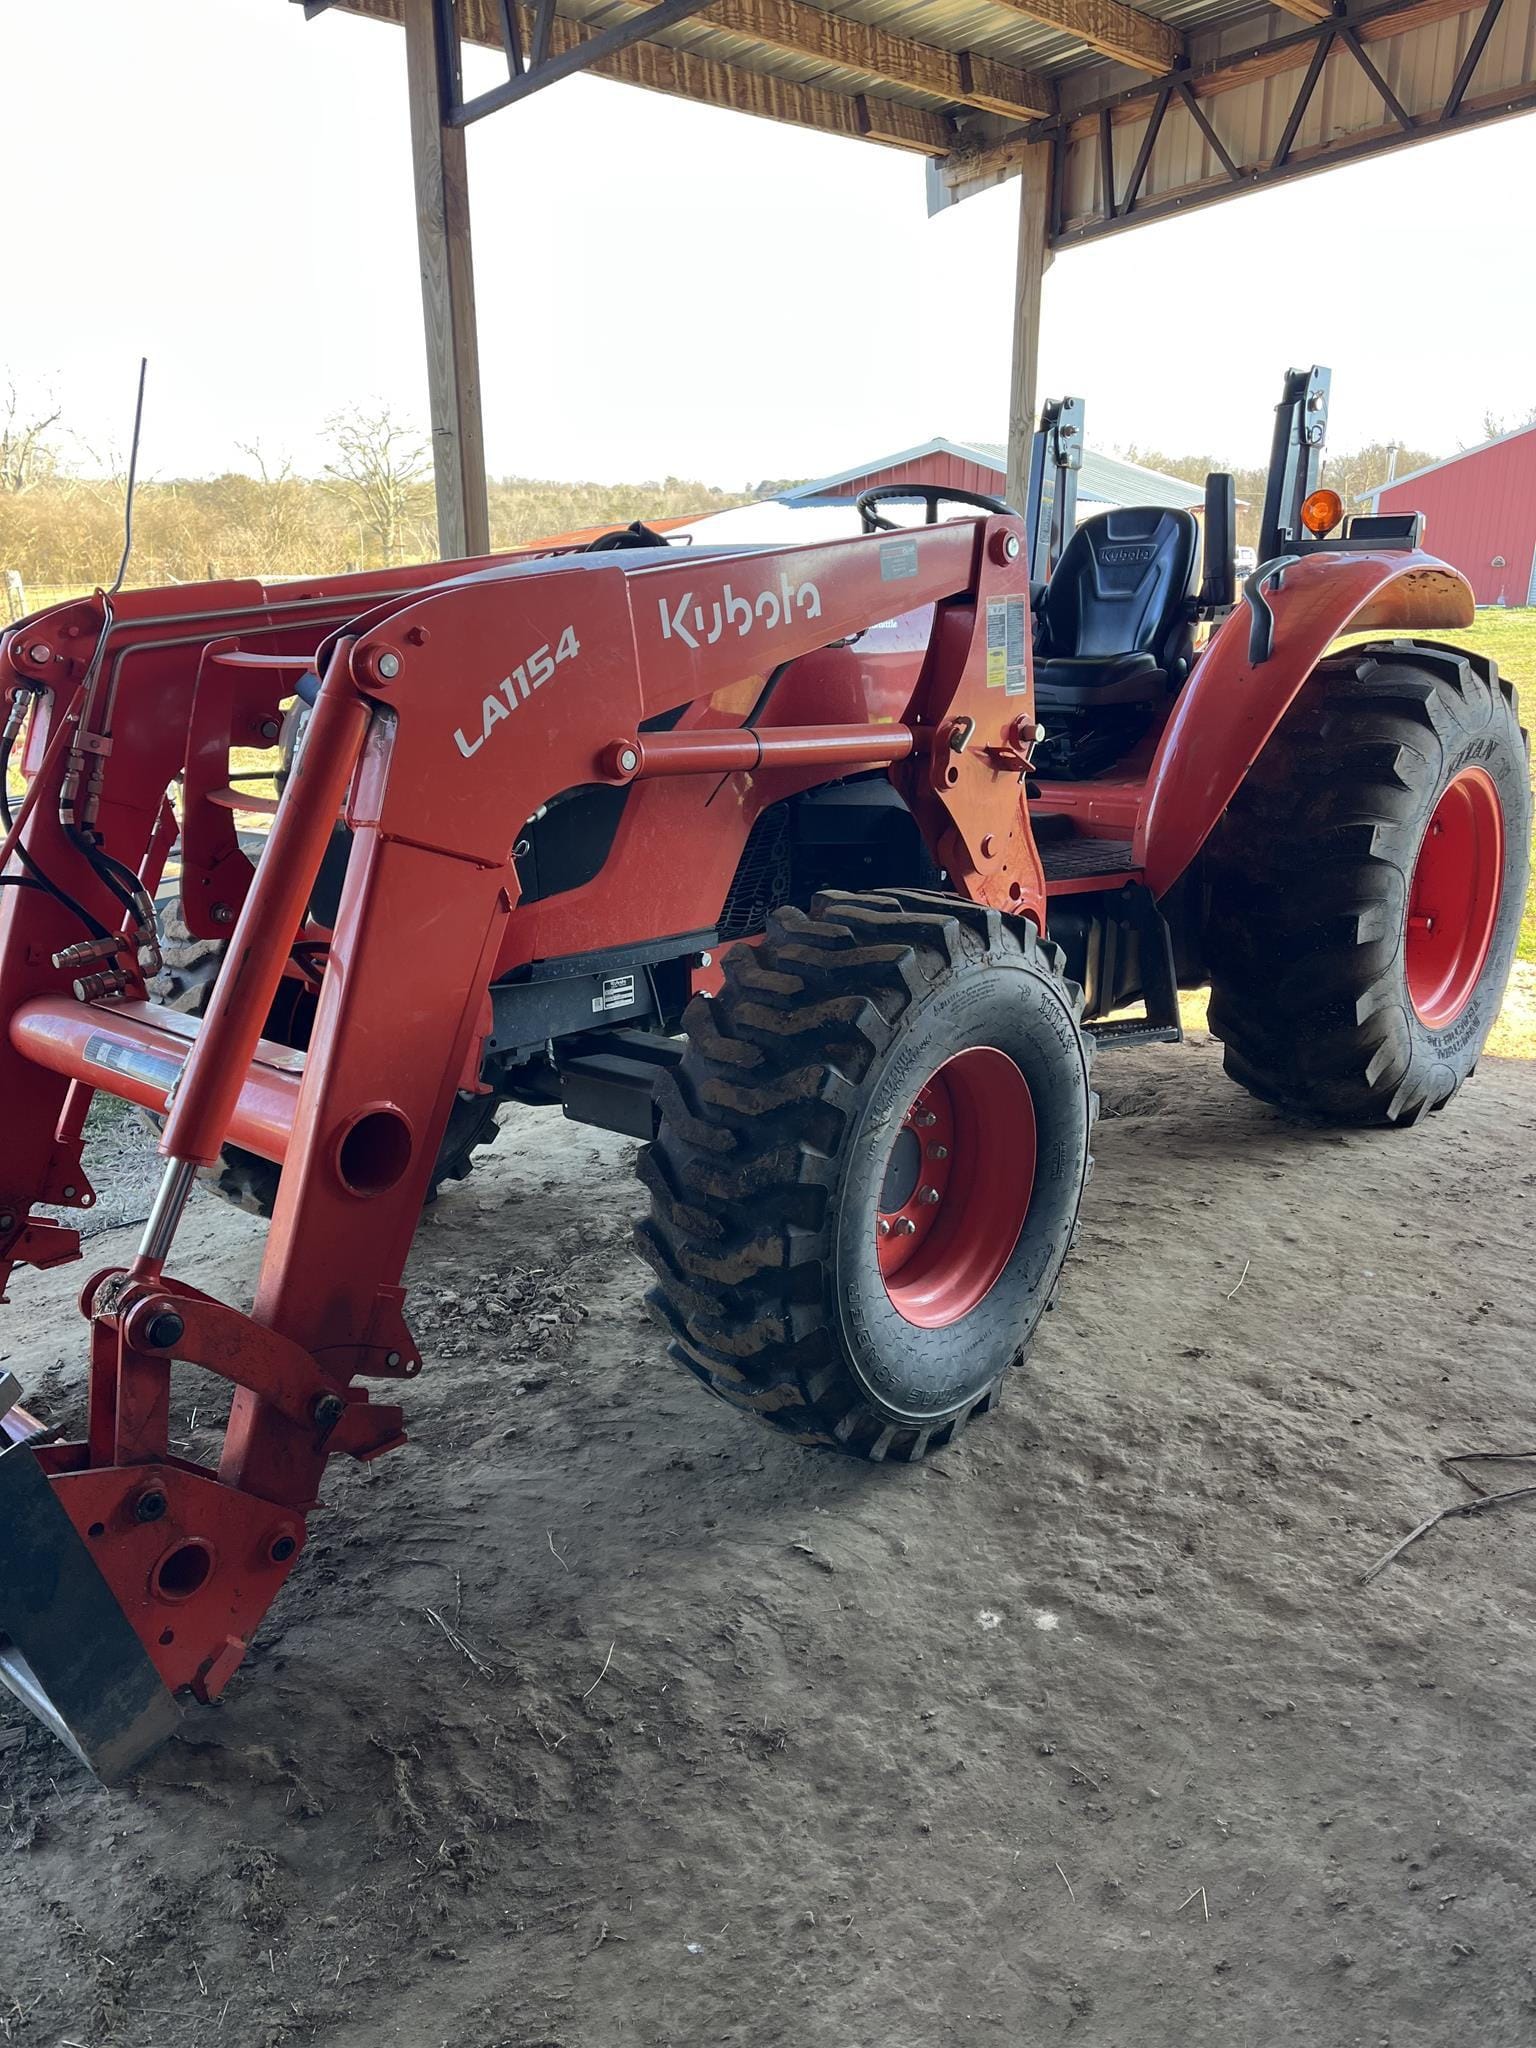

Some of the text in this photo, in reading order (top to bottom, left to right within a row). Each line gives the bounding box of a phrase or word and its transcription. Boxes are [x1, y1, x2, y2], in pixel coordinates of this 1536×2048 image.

[1101, 548, 1149, 562] Kubota
[658, 572, 822, 649] Kubota
[453, 624, 581, 759] LA1154
[1039, 993, 1076, 1054] TITAN
